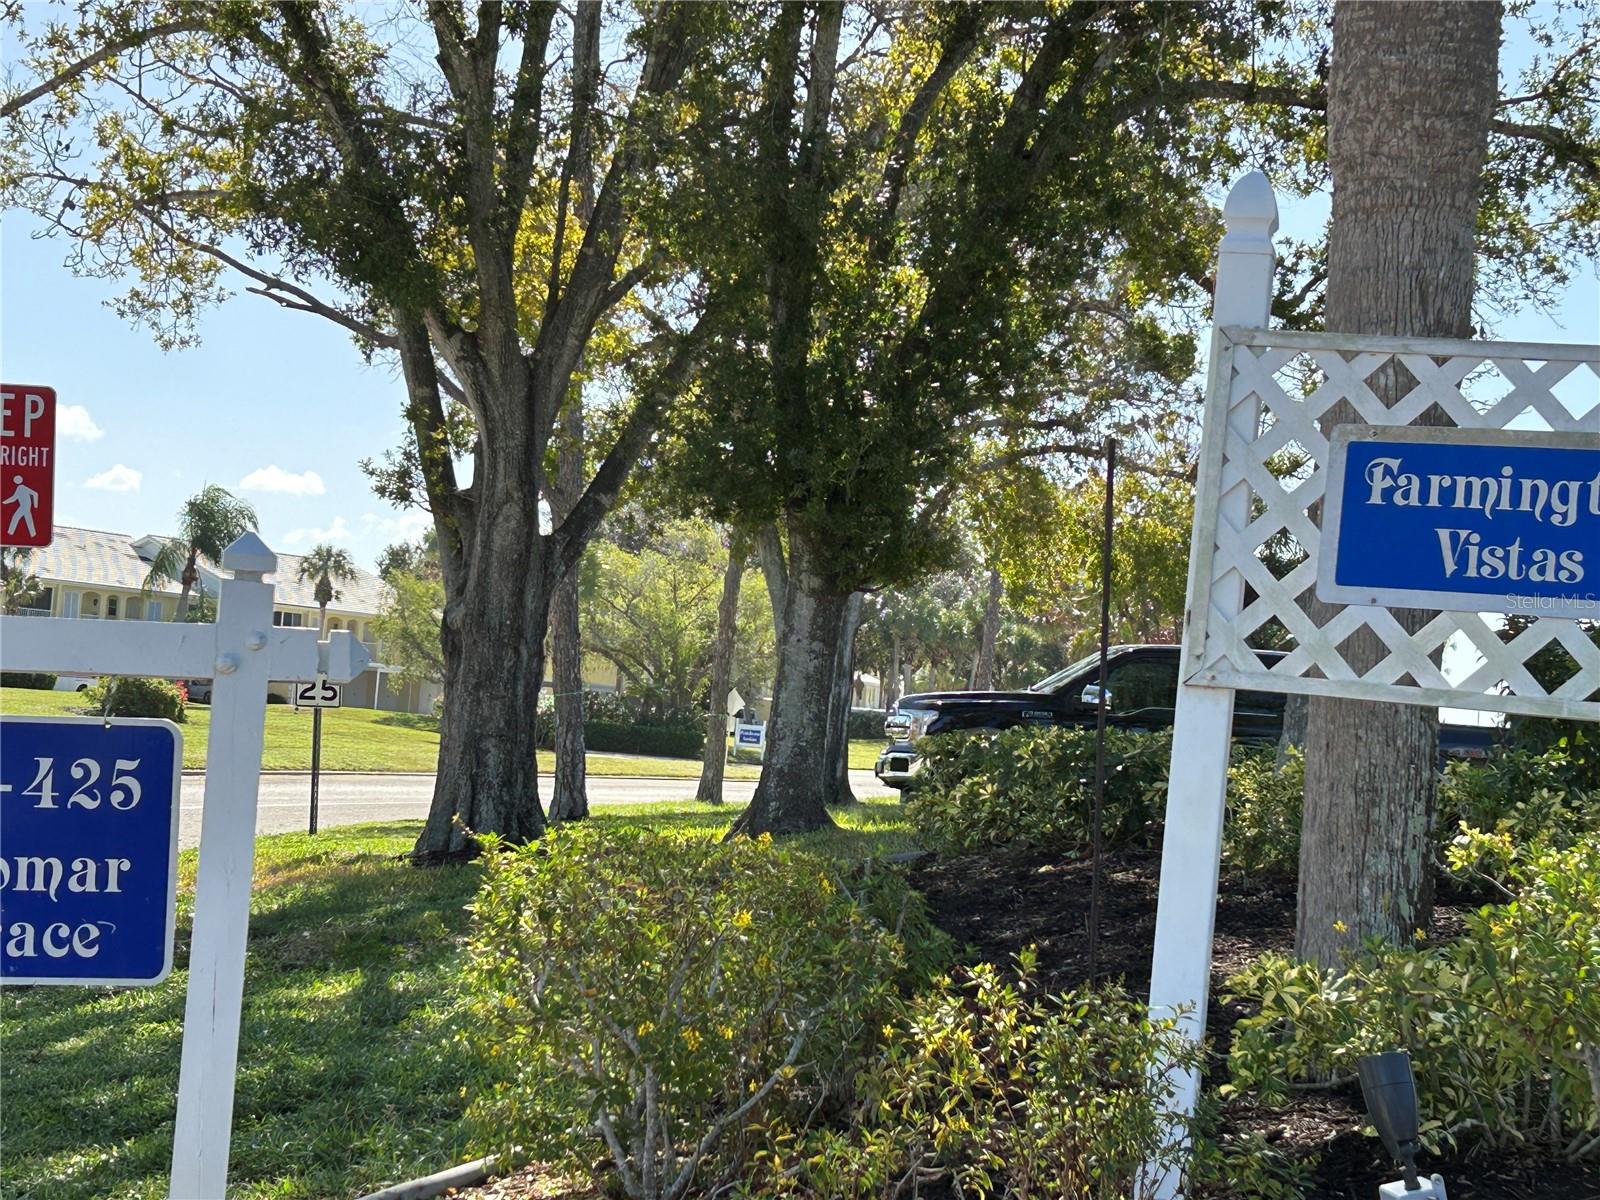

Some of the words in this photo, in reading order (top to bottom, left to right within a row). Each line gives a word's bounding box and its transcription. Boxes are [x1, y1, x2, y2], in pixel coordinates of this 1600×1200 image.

[0, 392, 46, 438] EP
[0, 445, 50, 468] RIGHT
[1434, 528, 1585, 584] Vistas
[298, 679, 338, 702] 25
[0, 921, 100, 959] ace
